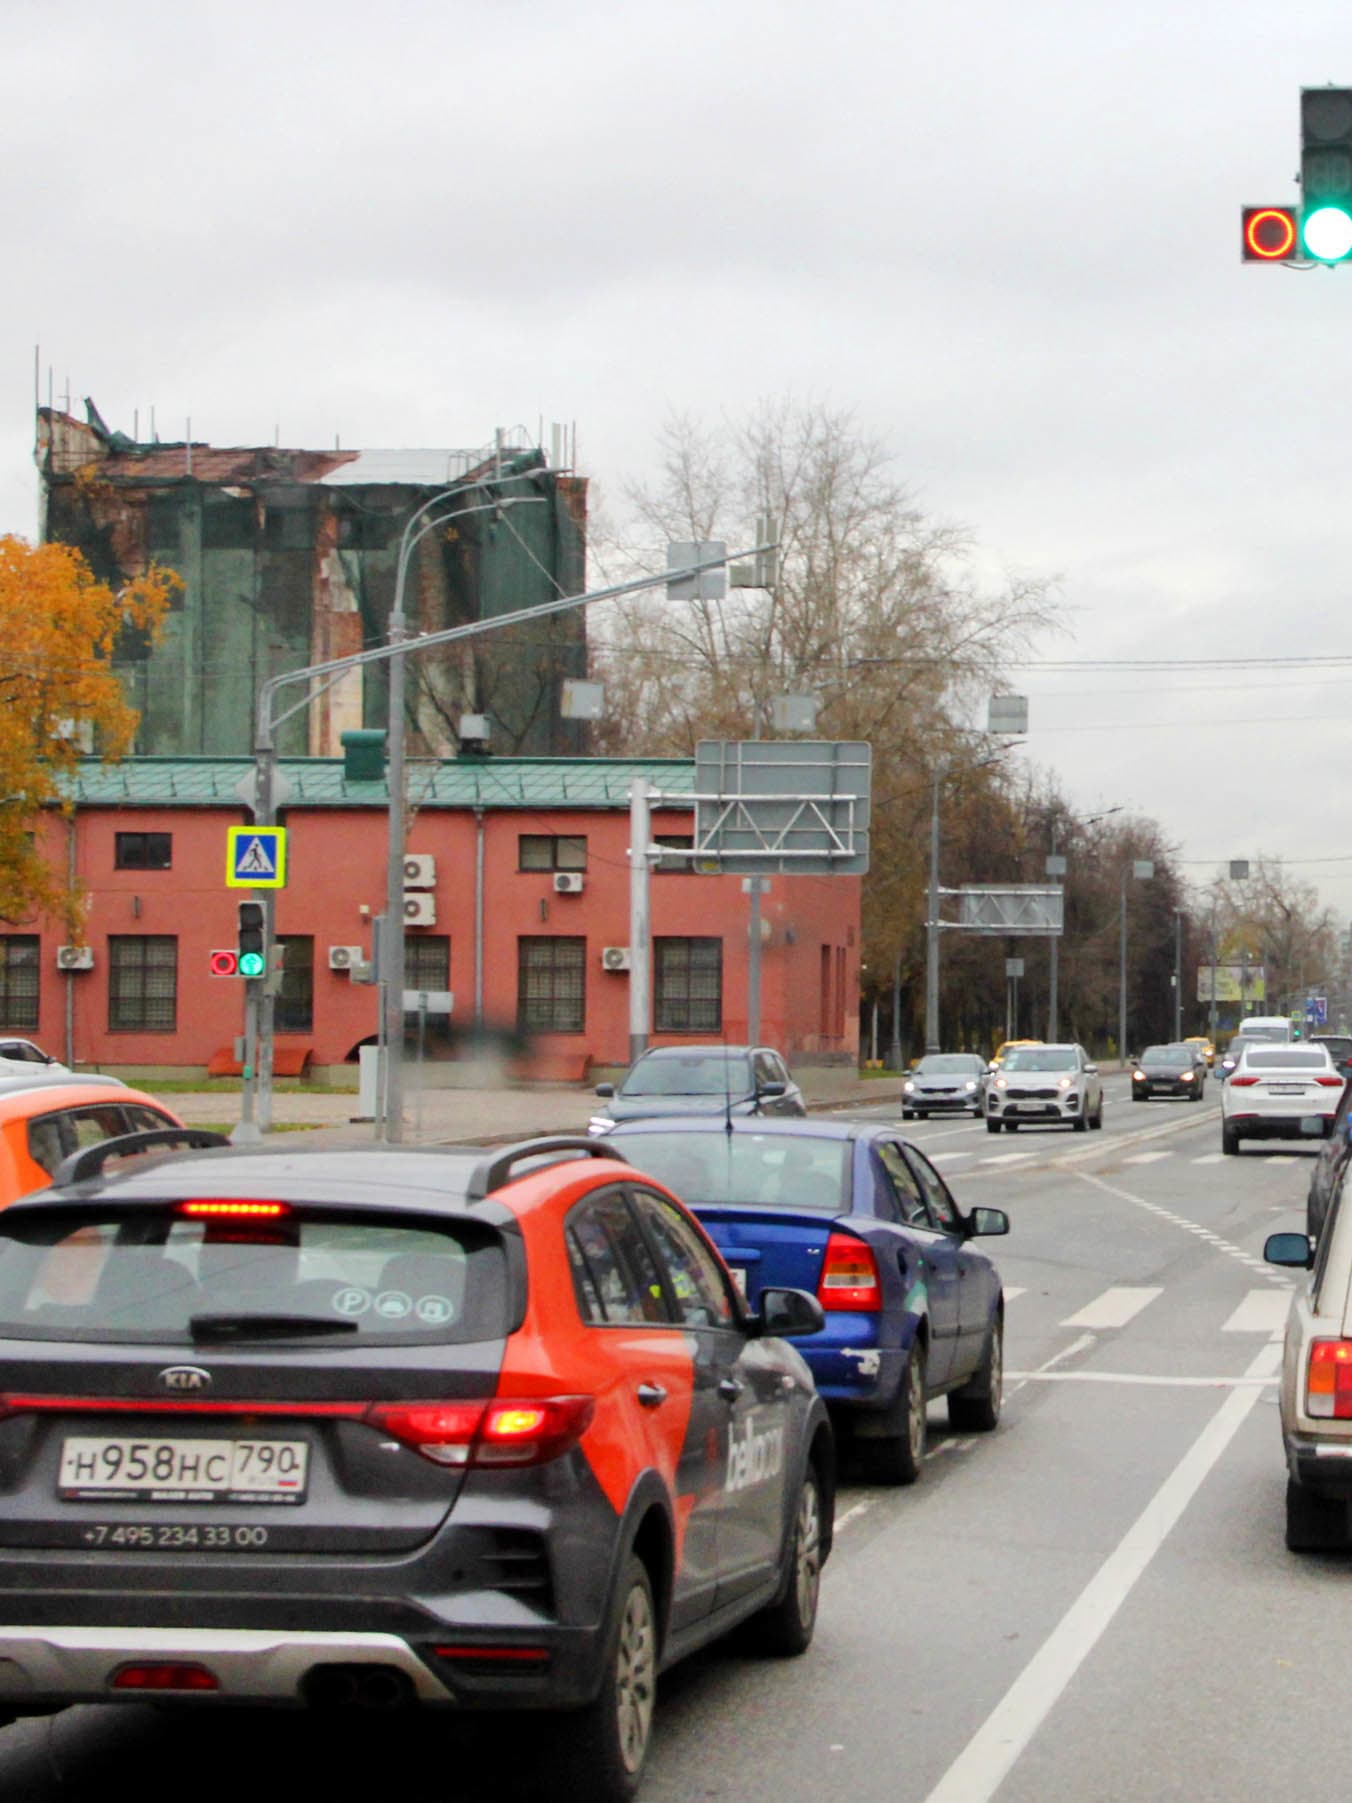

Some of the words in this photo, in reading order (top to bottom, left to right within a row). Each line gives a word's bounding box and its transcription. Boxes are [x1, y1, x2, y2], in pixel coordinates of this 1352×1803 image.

[164, 1374, 202, 1389] KIA
[238, 1445, 297, 1473] 790
[111, 1526, 154, 1545] 495
[158, 1527, 199, 1545] 234
[203, 1527, 231, 1545] 33
[234, 1527, 268, 1545] 00
